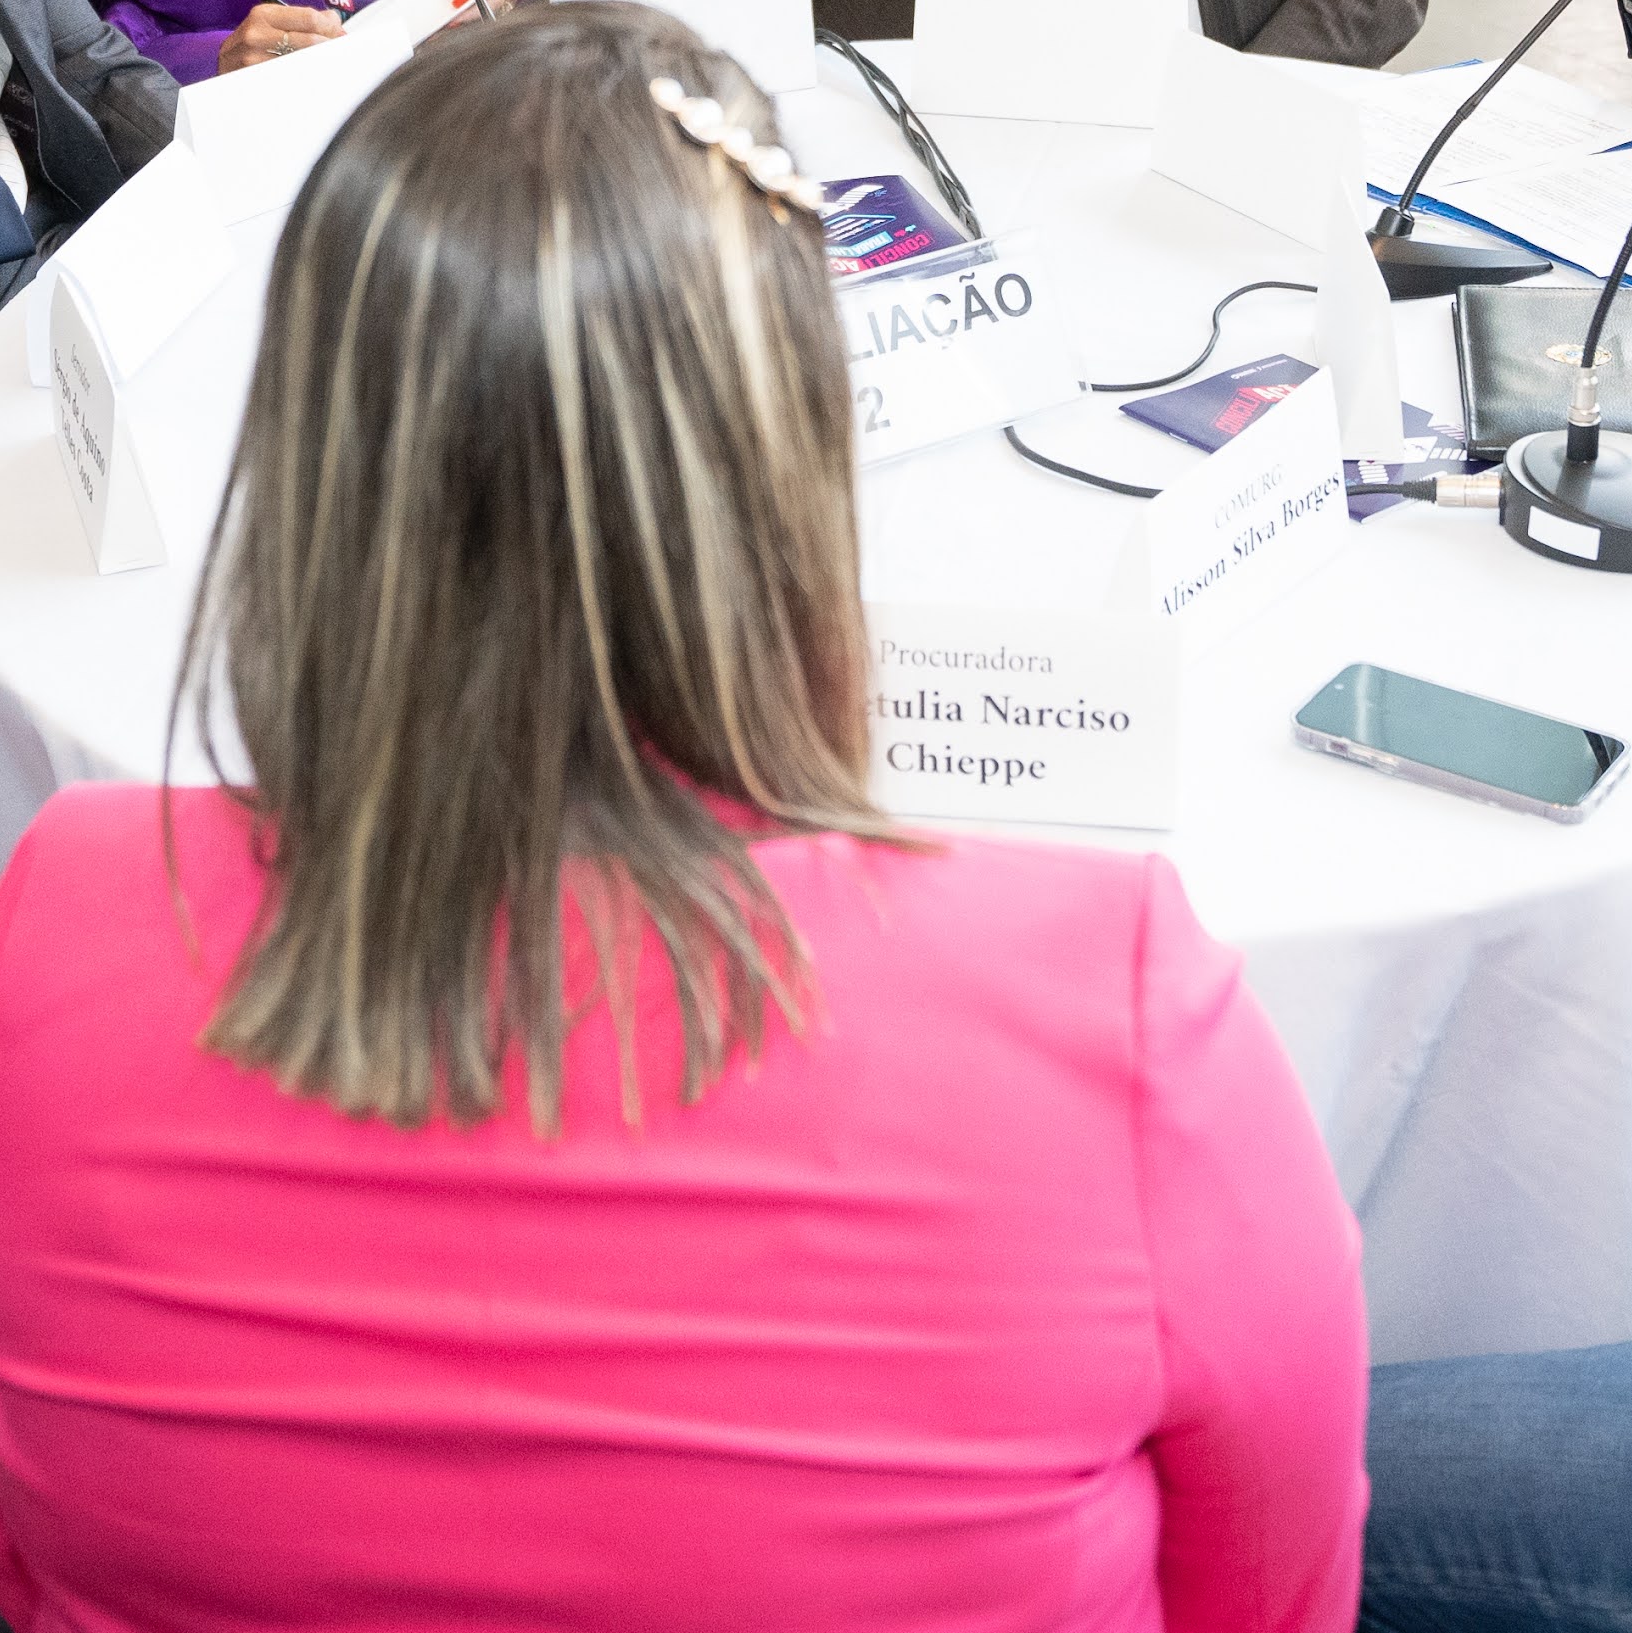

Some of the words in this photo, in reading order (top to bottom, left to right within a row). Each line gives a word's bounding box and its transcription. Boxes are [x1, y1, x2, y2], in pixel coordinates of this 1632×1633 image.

[868, 232, 932, 270] CONCILI
[1161, 558, 1227, 616] Alisson
[1233, 520, 1276, 565] Silva
[1282, 472, 1340, 528] Borges
[879, 639, 1054, 674] Procuradora
[981, 694, 1131, 734] Narciso
[885, 742, 1048, 787] Chieppe
